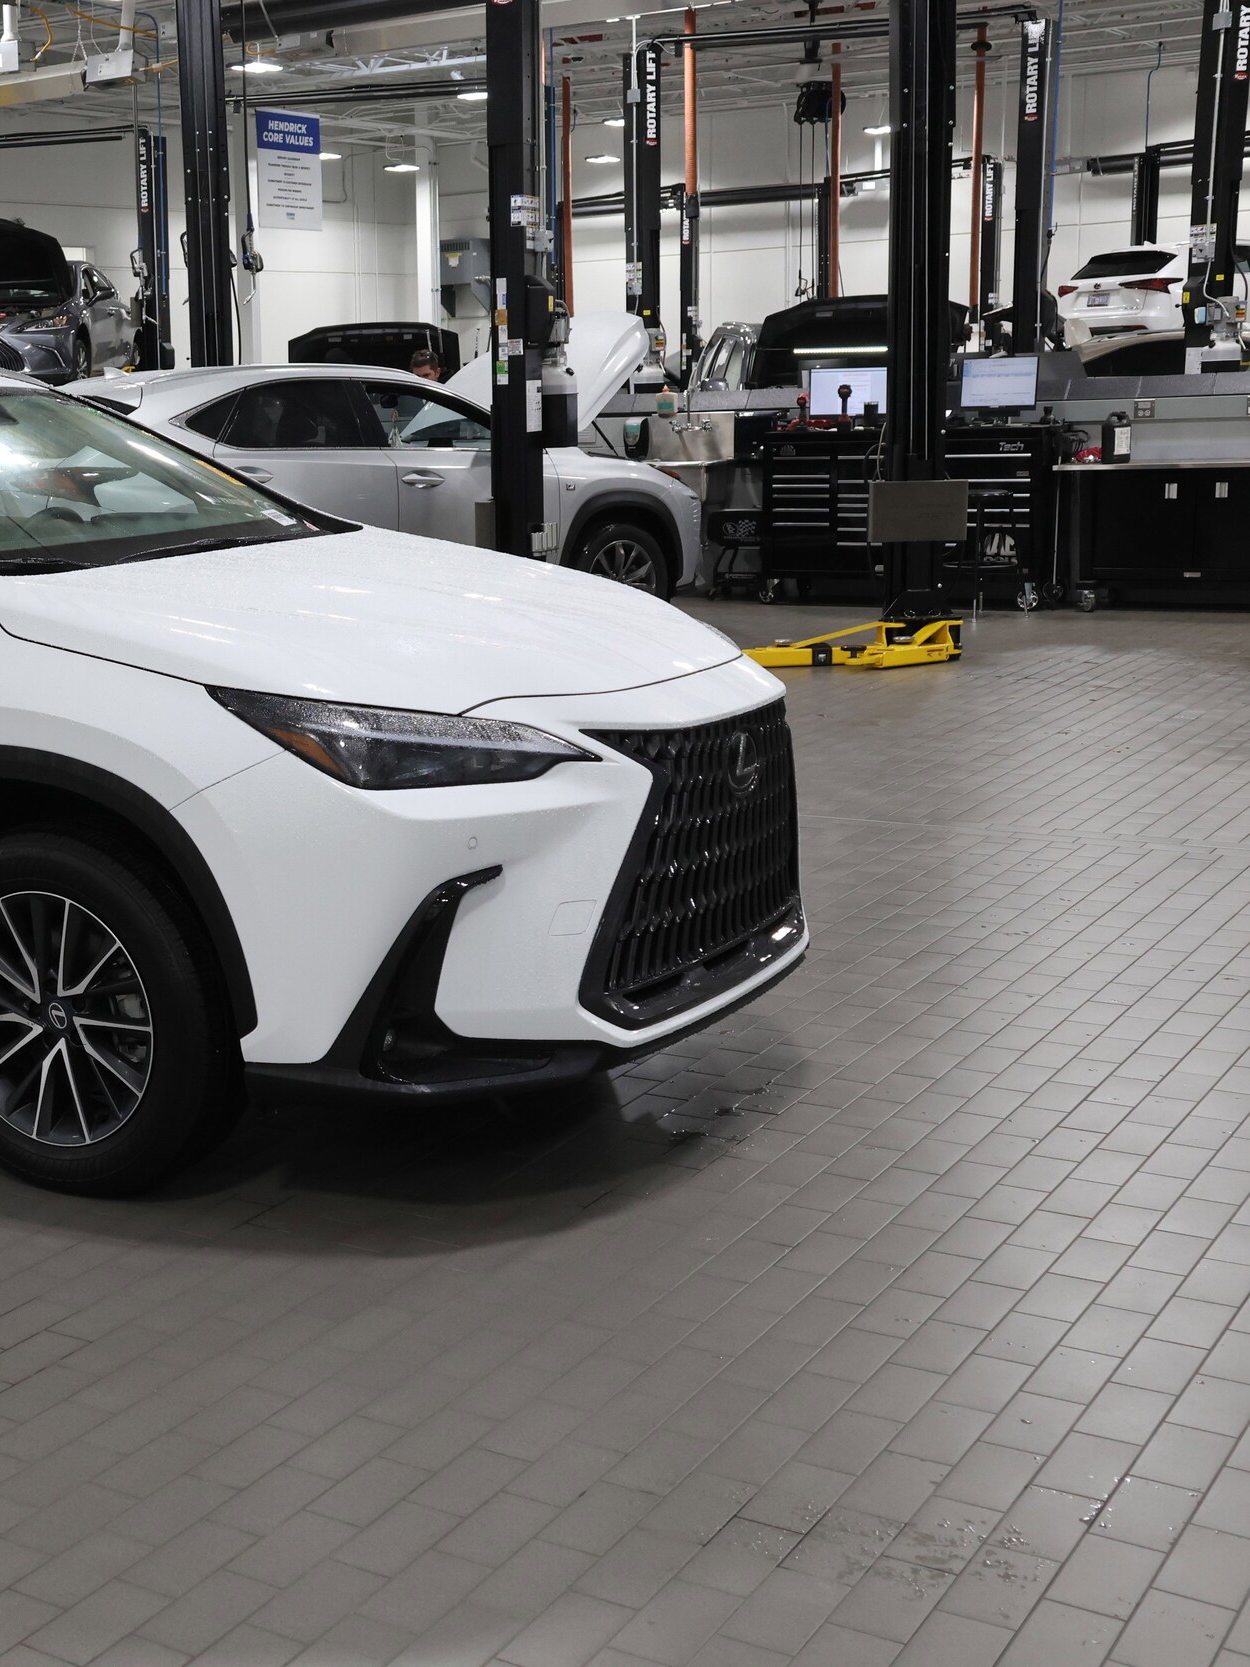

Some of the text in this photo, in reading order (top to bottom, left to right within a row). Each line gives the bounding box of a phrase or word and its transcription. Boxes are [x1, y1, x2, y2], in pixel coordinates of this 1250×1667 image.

[1235, 4, 1250, 72] ROTARY
[646, 50, 656, 80] LIFT
[1025, 56, 1039, 114] ROTARY
[268, 119, 308, 134] HENDRICK
[646, 83, 657, 139] ROTARY
[262, 131, 314, 147] CORE VALUES
[138, 137, 149, 208] ROTARY LIFT
[984, 183, 994, 217] ROTARY
[998, 441, 1025, 452] Tech
